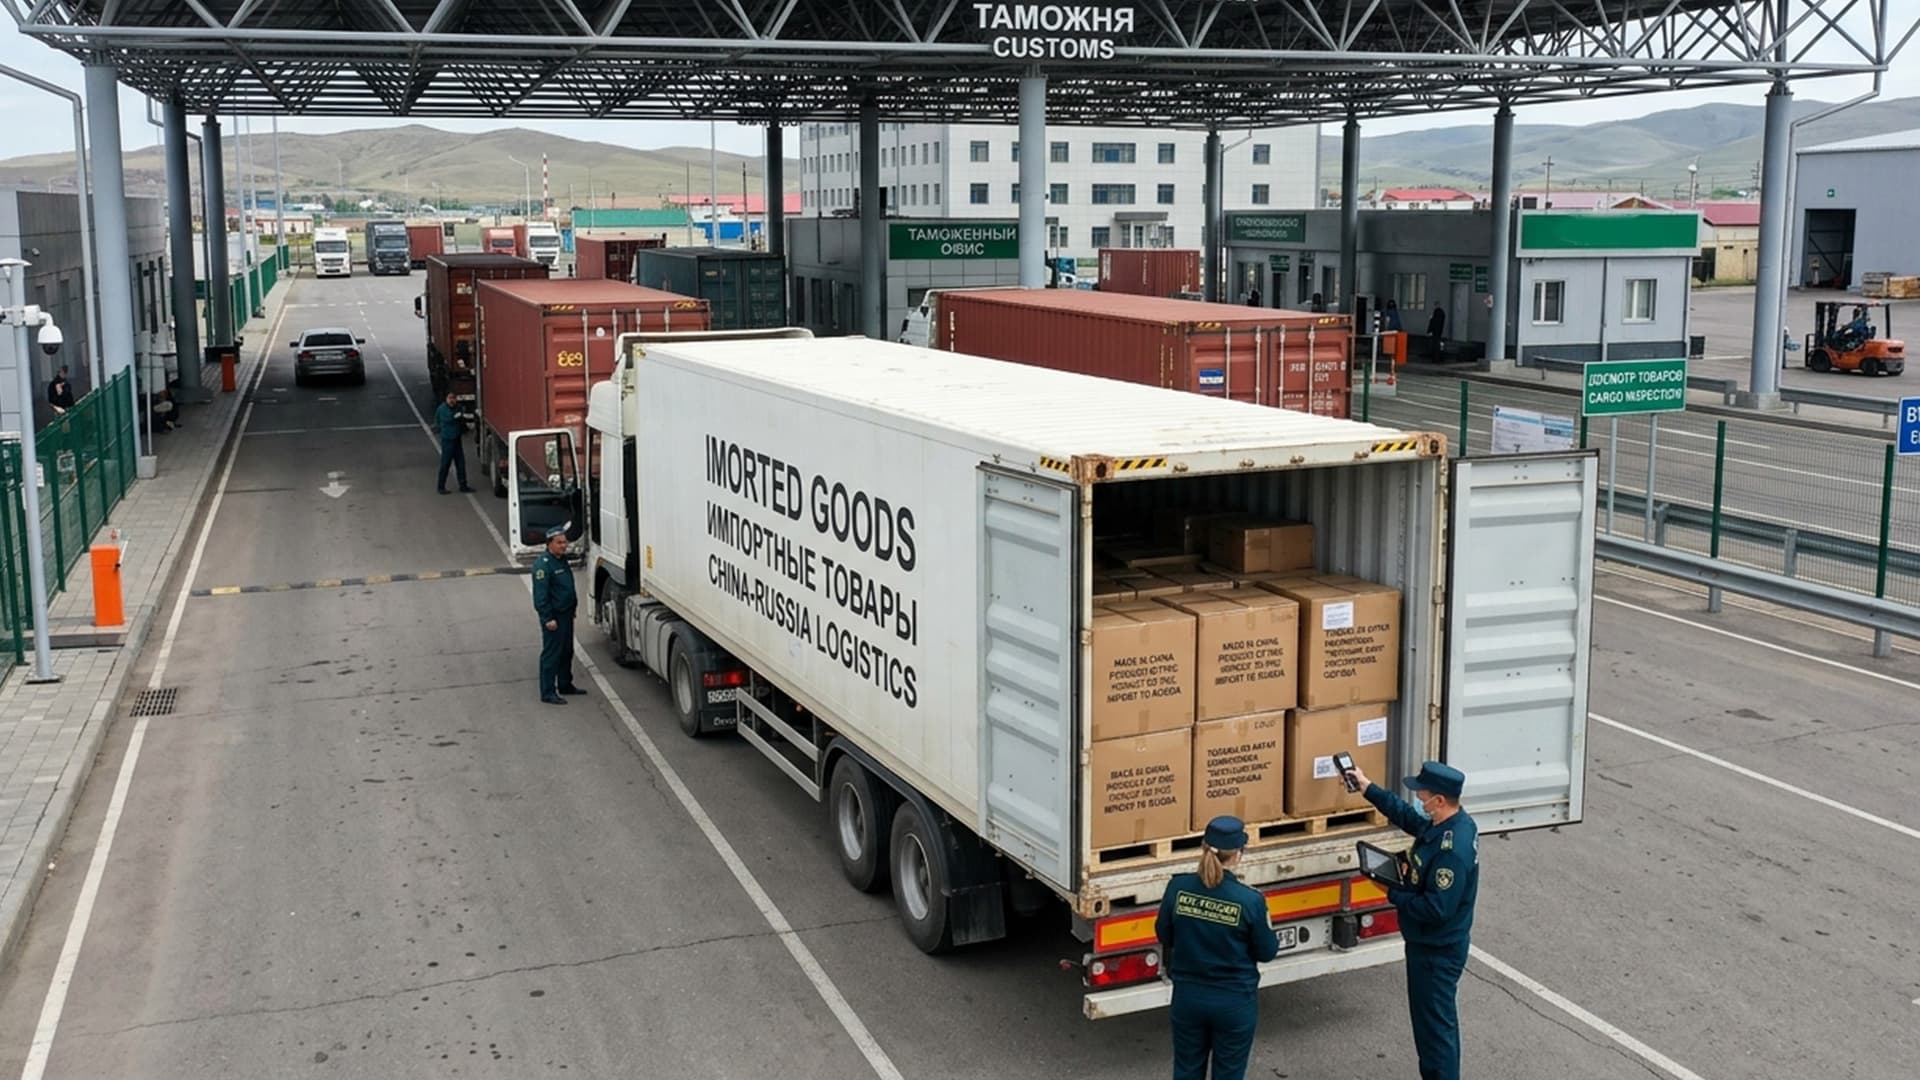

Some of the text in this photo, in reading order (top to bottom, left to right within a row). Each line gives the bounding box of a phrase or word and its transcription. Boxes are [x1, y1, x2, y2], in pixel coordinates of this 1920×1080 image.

[973, 4, 1134, 33] ТАМОЖНЯ
[993, 36, 1115, 59] CUSTOMS
[1588, 391, 1624, 404] CARGO
[706, 434, 916, 573] IMORTED GOODS
[707, 500, 917, 647] ИМПОРТНЫЕ ТОВАРЫ
[708, 553, 917, 710] CHINA-RUSSIA LOGISTICS
